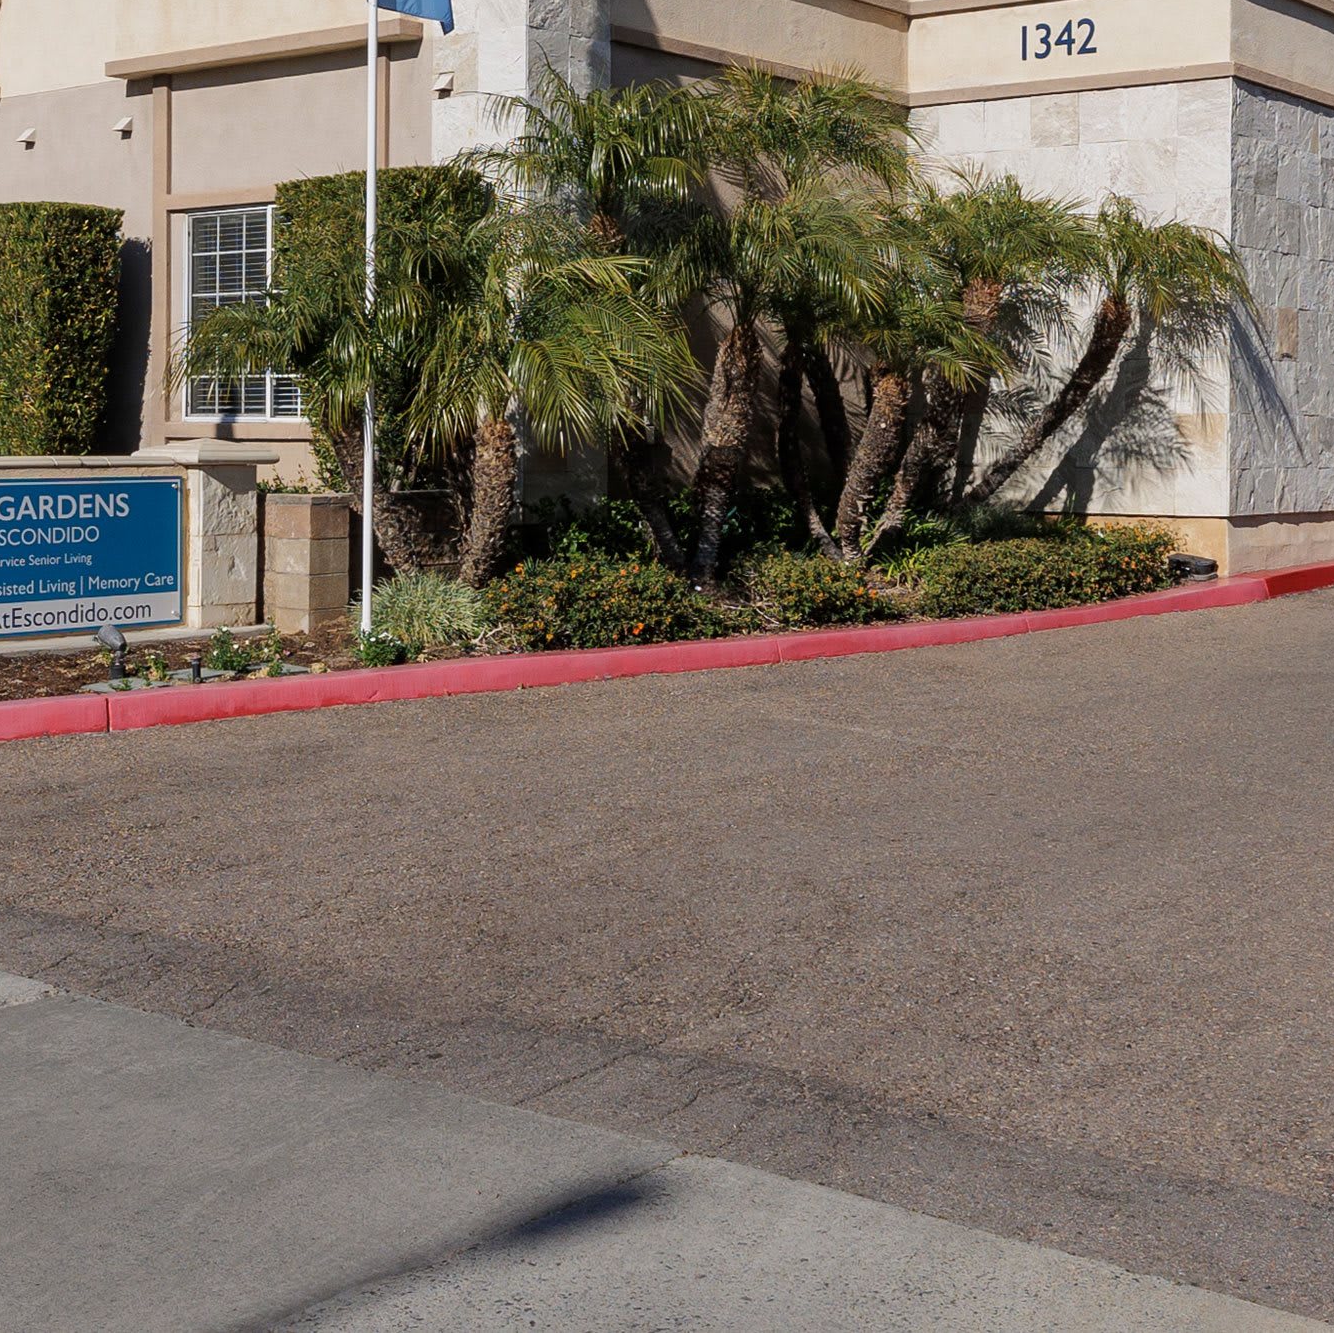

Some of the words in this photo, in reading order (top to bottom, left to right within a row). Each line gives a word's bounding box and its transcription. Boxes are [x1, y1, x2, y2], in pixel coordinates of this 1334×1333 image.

[1022, 18, 1097, 61] 1342
[28, 554, 61, 566] Senior
[64, 553, 92, 566] Living
[39, 578, 76, 596] Living
[88, 575, 140, 592] Memory
[144, 572, 174, 587] Care
